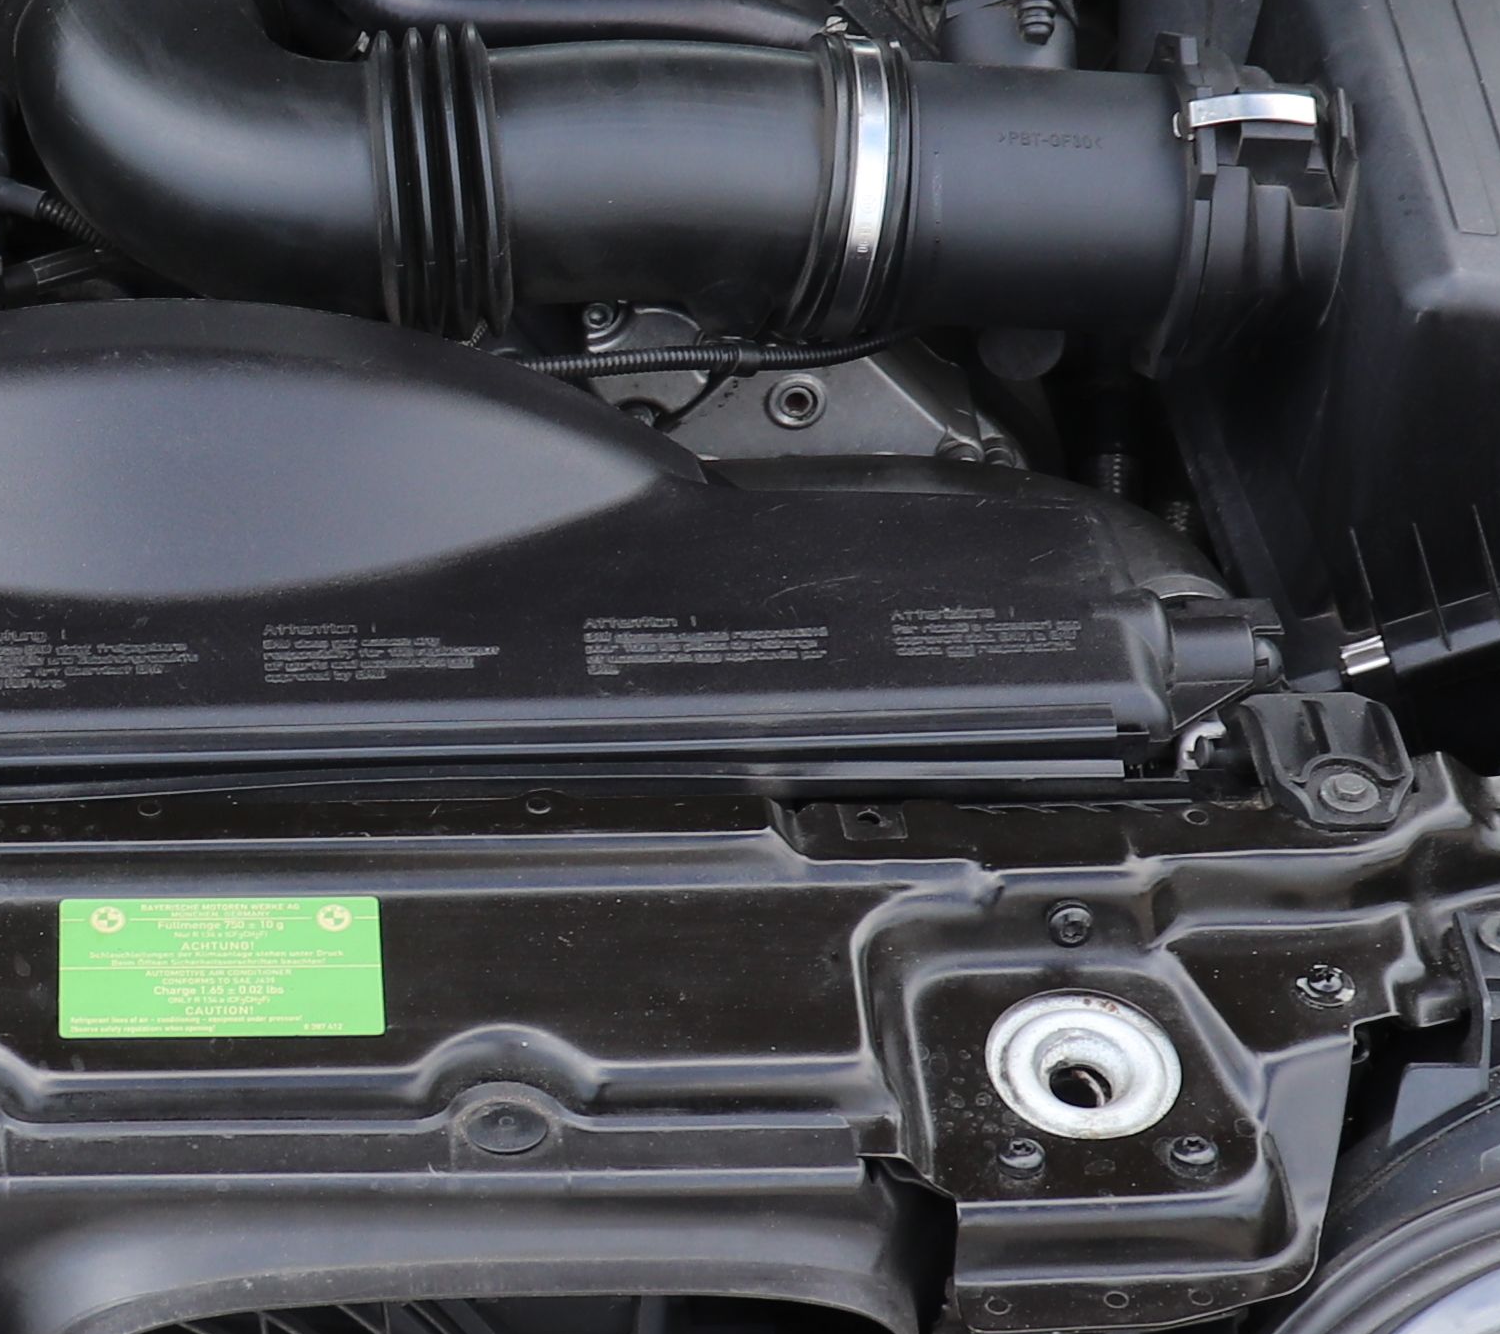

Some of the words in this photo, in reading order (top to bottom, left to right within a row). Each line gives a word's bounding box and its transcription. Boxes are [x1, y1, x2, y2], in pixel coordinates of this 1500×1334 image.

[260, 919, 274, 929] 10
[181, 940, 255, 951] ACHTUNG!
[153, 985, 197, 996] Charge
[266, 985, 285, 995] lbs
[184, 1006, 254, 1016] CAUTION!
